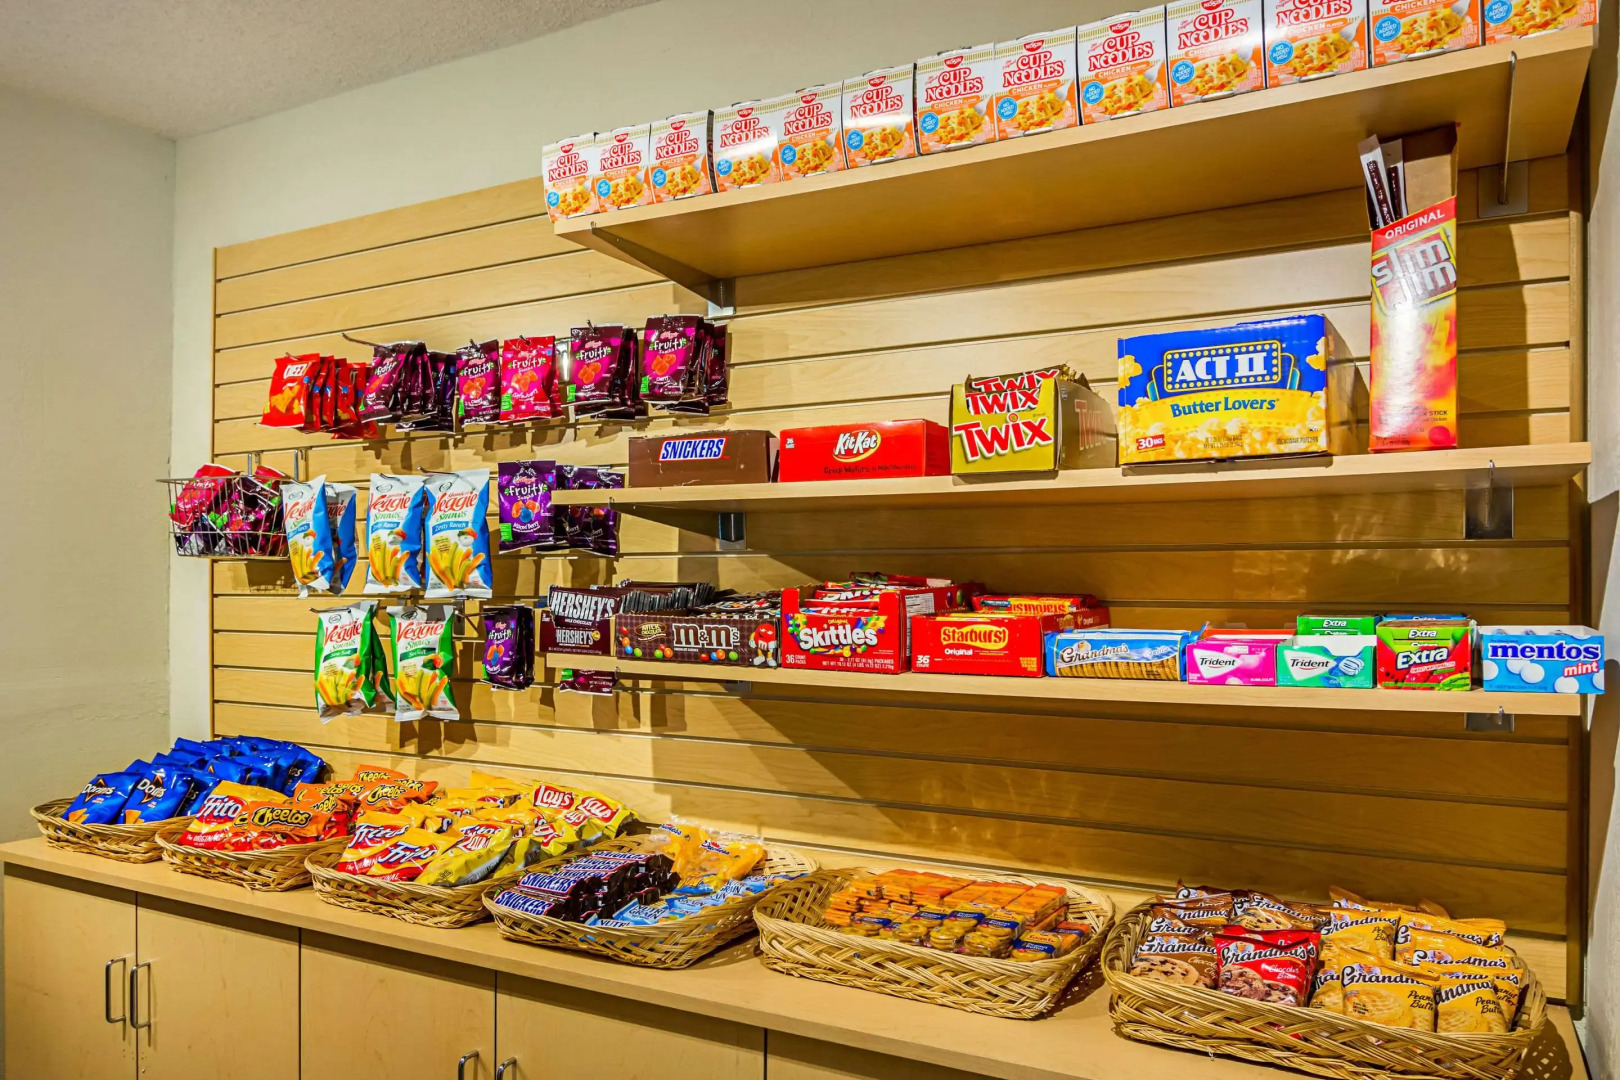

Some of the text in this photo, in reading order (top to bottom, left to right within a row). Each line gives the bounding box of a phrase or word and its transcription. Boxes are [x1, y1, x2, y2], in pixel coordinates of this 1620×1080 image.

[1193, 9, 1234, 30] CUP
[1276, 0, 1352, 28] NOODLES
[1103, 32, 1140, 51] CUP
[1178, 18, 1249, 50] NOODLES
[1017, 51, 1052, 70] CUP
[1088, 42, 1153, 72] NOODLES
[938, 68, 971, 85] CUP
[1002, 60, 1064, 88] NOODLES
[1099, 66, 1132, 78] CHICKEN
[862, 86, 892, 102] CUP
[925, 78, 983, 103] NOODLES
[1011, 83, 1043, 94] CHICKEN
[795, 103, 823, 119] CUP
[851, 95, 903, 118] NOODLES
[732, 118, 759, 133] CUP
[784, 112, 832, 136] NOODLES
[665, 130, 690, 145] CUP
[720, 126, 769, 148] NOODLES
[610, 142, 633, 157] CUP
[656, 138, 698, 159] NOODLES
[557, 153, 579, 167] CUP
[600, 151, 641, 171] NOODLES
[549, 161, 588, 182] NOODLES
[1385, 204, 1445, 239] ORIGINAL
[1175, 351, 1267, 382] ACT II
[1170, 397, 1276, 418] Butter Lovers
[661, 438, 725, 460] SNICKERS
[1138, 437, 1153, 449] 30
[369, 493, 411, 513] Veggie
[432, 491, 478, 516] Veggie
[551, 592, 615, 622] HERSHEY'S
[324, 620, 362, 646] Veggie
[397, 621, 444, 643] Veggie
[1323, 619, 1347, 628] Extra
[556, 629, 593, 645] HERSHEY'S
[800, 624, 878, 650] Skittles
[942, 628, 1006, 644] Starburst
[1408, 629, 1437, 639] Extra
[785, 654, 795, 664] 36
[916, 655, 930, 664] 36
[945, 648, 973, 656] Original
[1060, 643, 1129, 664] Grandma's
[1396, 647, 1450, 670] Extra
[1489, 640, 1601, 660] mentos
[1199, 658, 1236, 666] Trident
[1290, 658, 1330, 668] Trident
[1563, 662, 1599, 678] mint
[252, 807, 312, 827] Cheetos
[521, 873, 577, 892] SNICKERS
[1221, 946, 1307, 968] Grandma's
